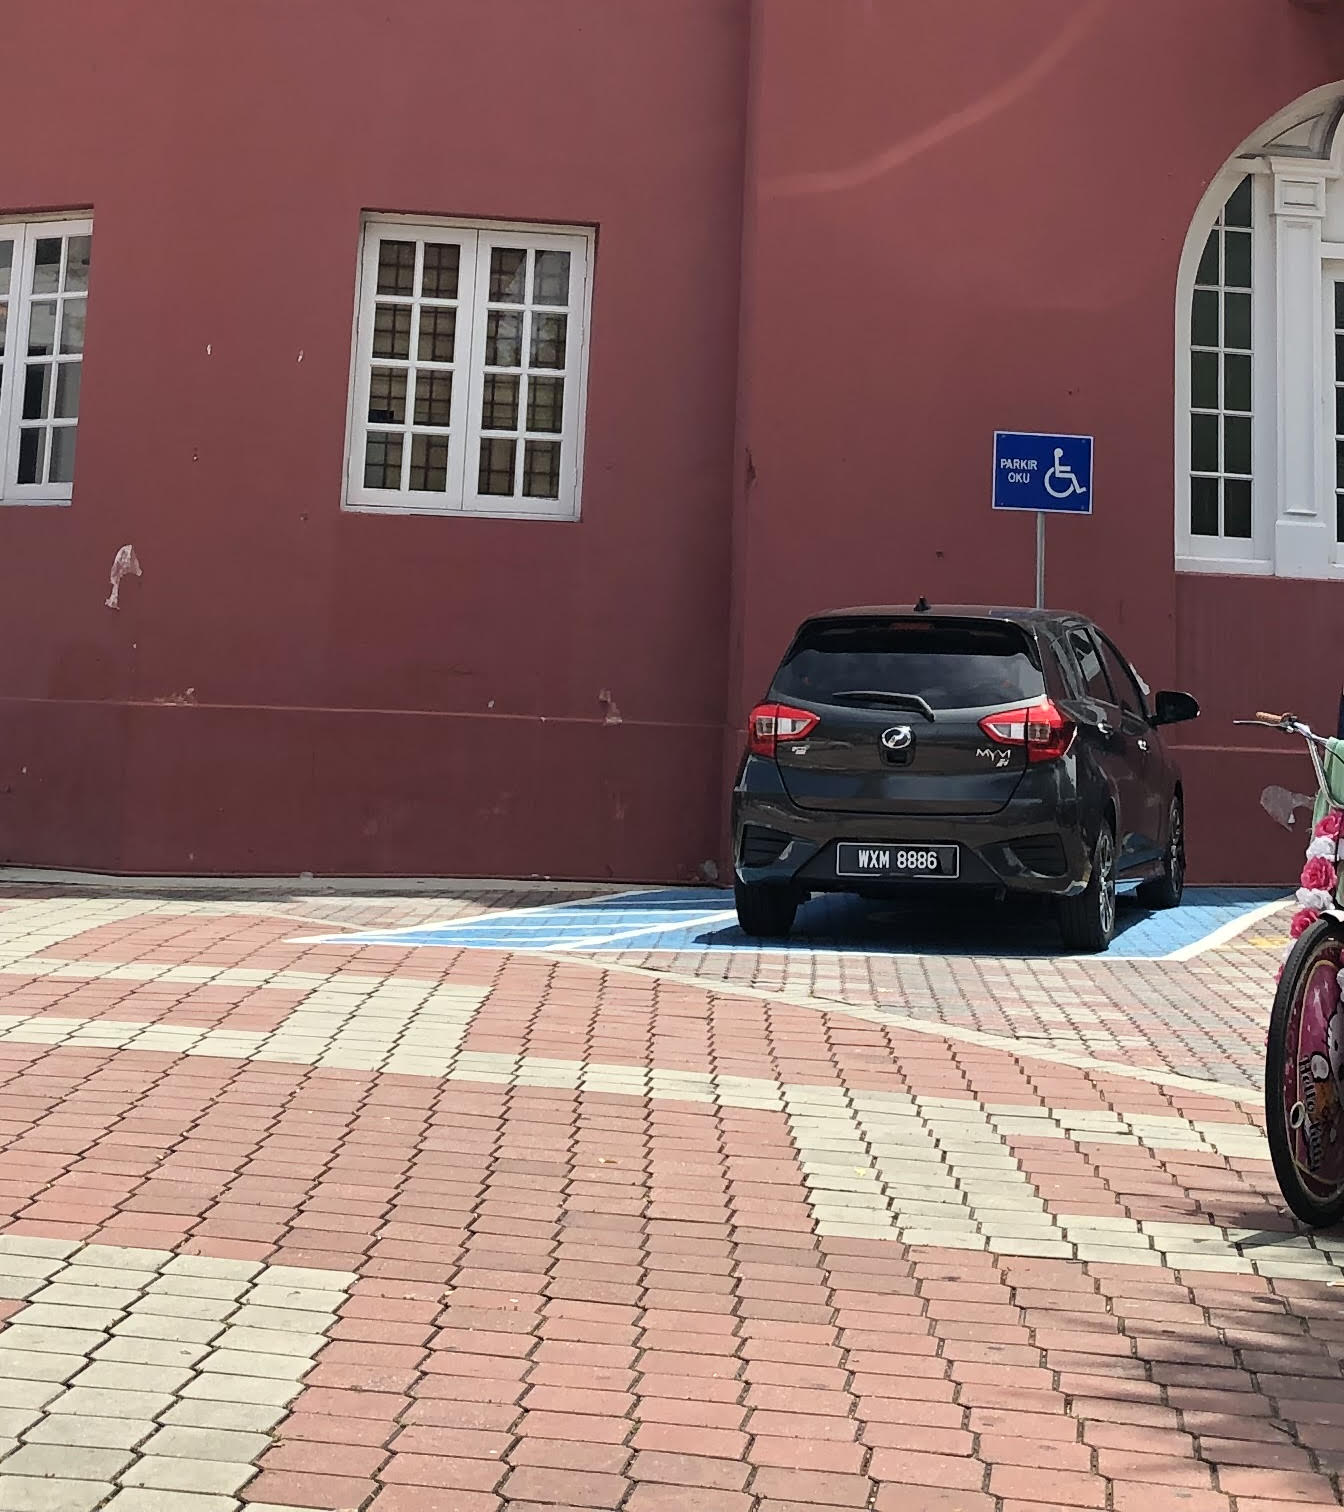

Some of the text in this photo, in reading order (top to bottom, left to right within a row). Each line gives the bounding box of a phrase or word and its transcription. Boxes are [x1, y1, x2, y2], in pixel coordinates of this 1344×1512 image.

[1000, 458, 1038, 471] PARKIR
[1007, 472, 1031, 484] OKU
[858, 850, 938, 870] WXM 8886
